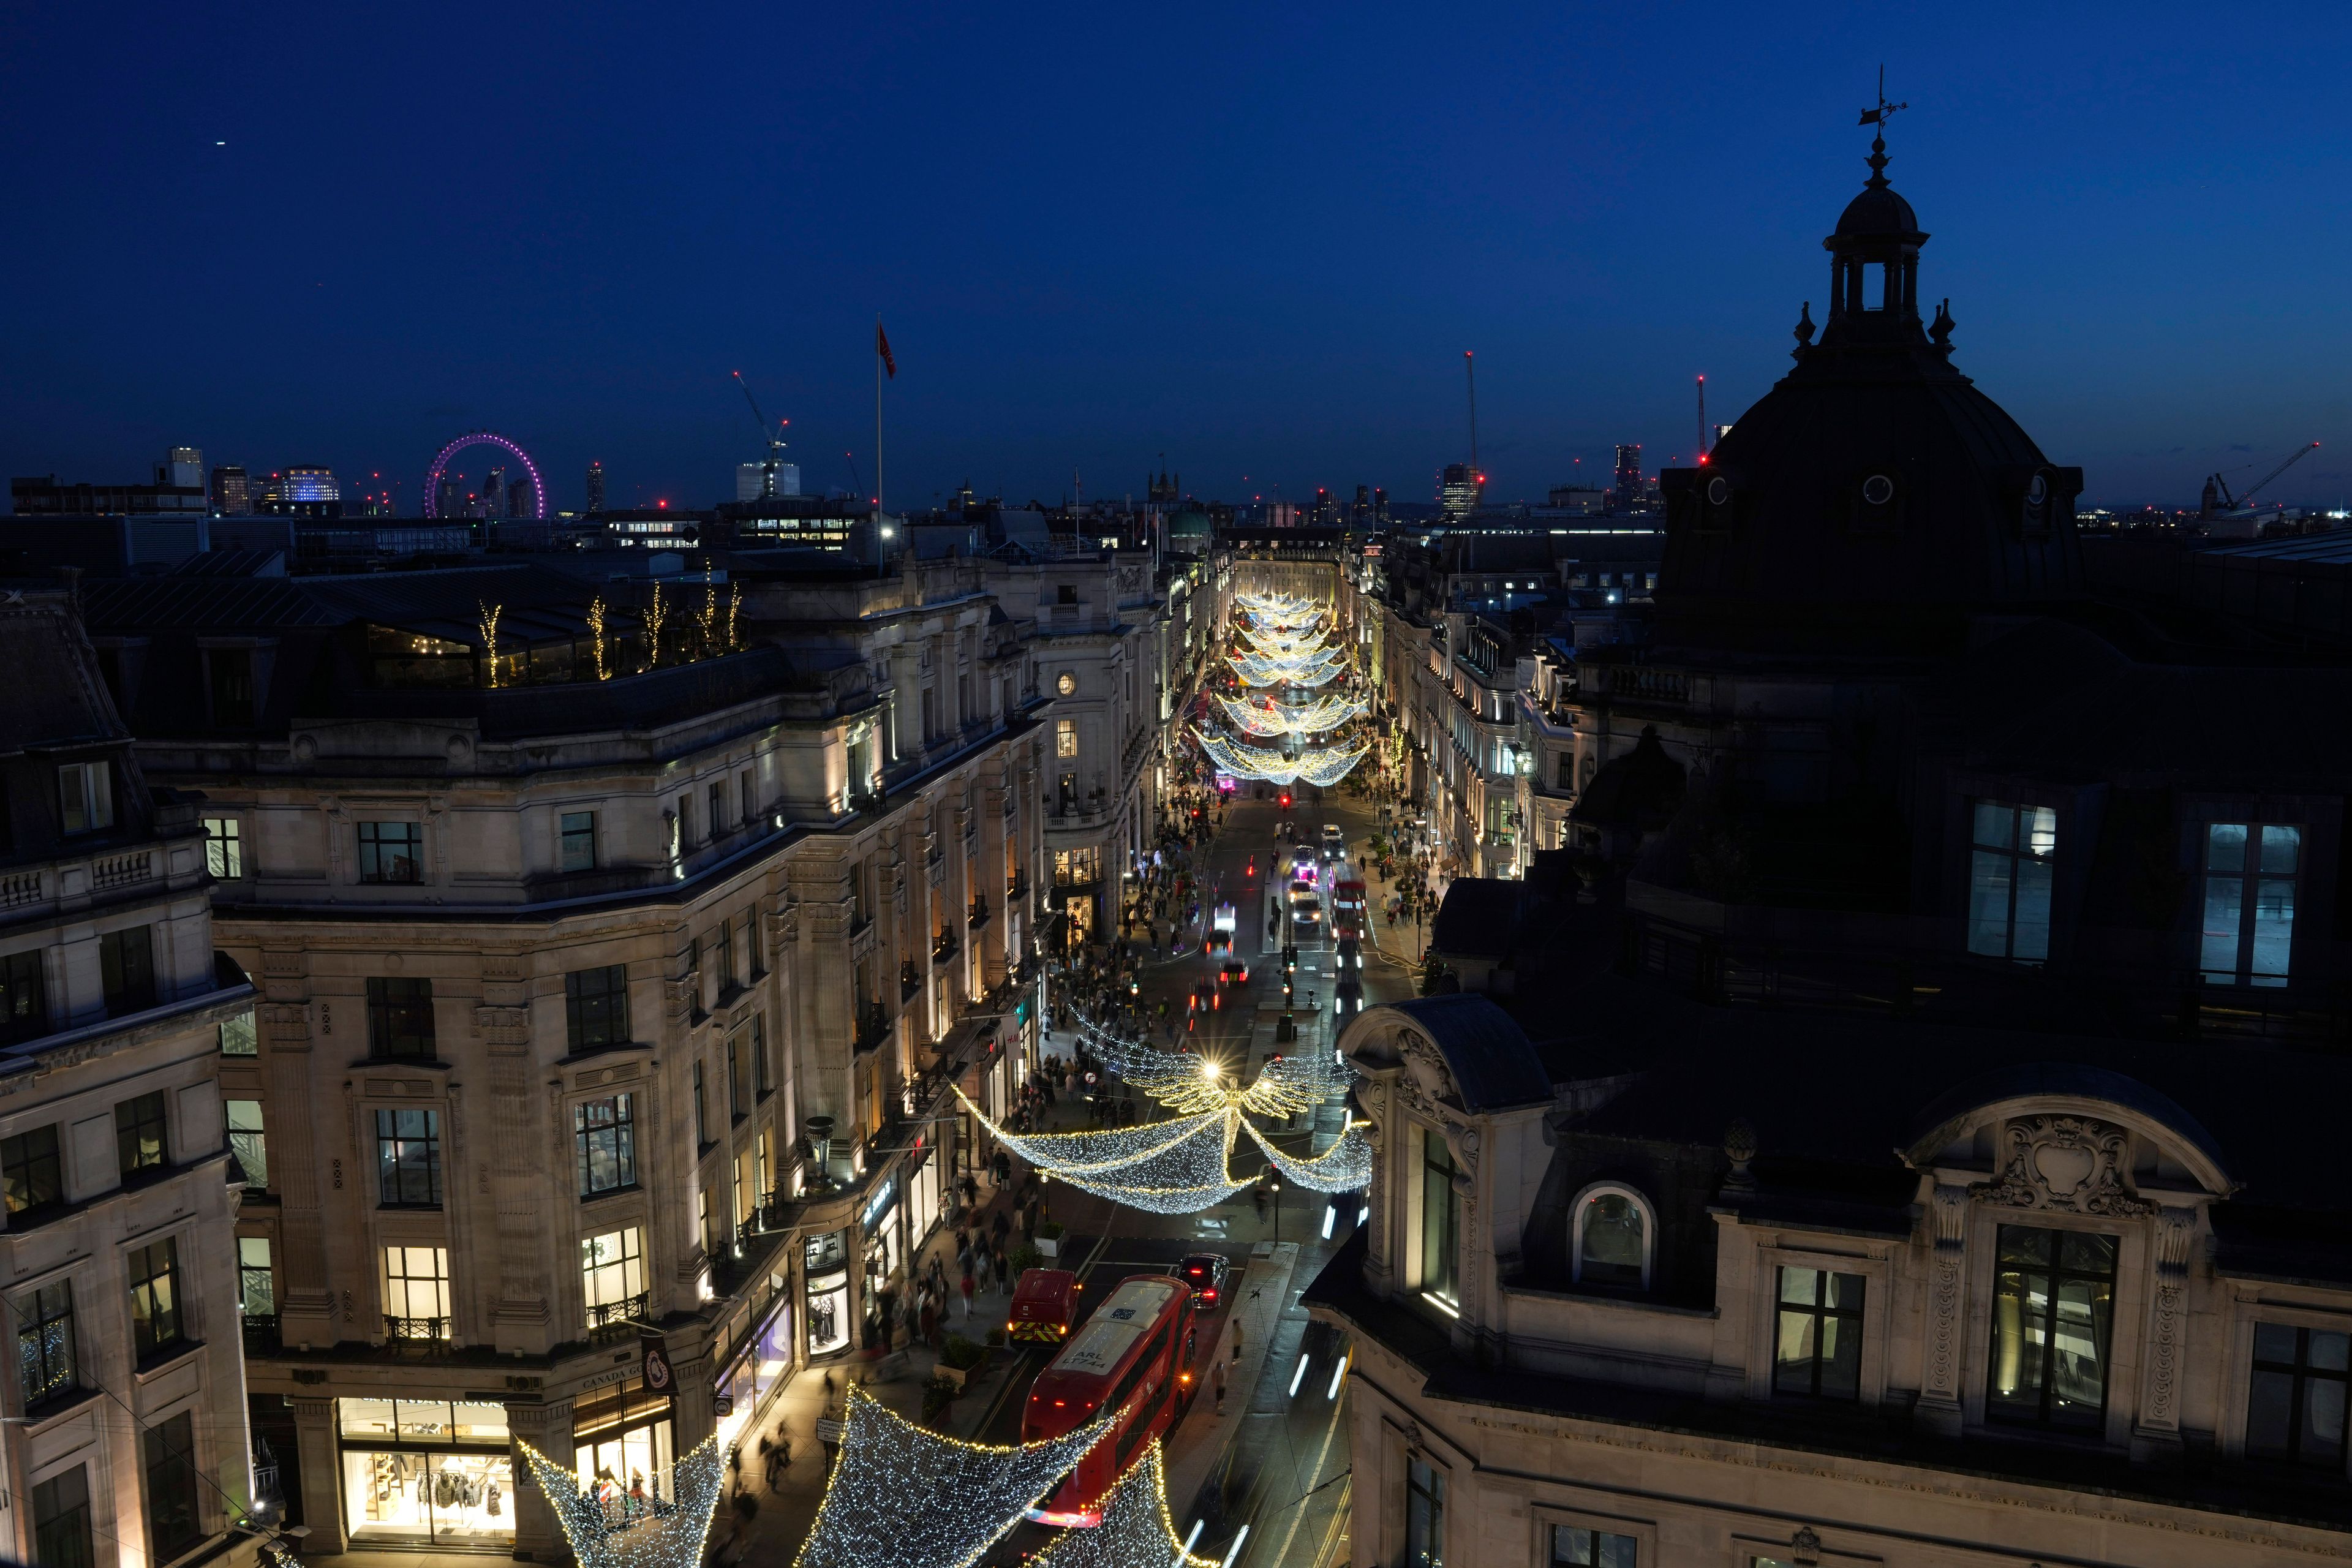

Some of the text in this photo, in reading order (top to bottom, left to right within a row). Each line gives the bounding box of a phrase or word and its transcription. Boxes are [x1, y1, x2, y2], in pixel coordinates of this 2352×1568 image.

[1074, 1351, 1103, 1360] ARL
[1062, 1358, 1106, 1368] LT744
[583, 1370, 625, 1389] CANADA
